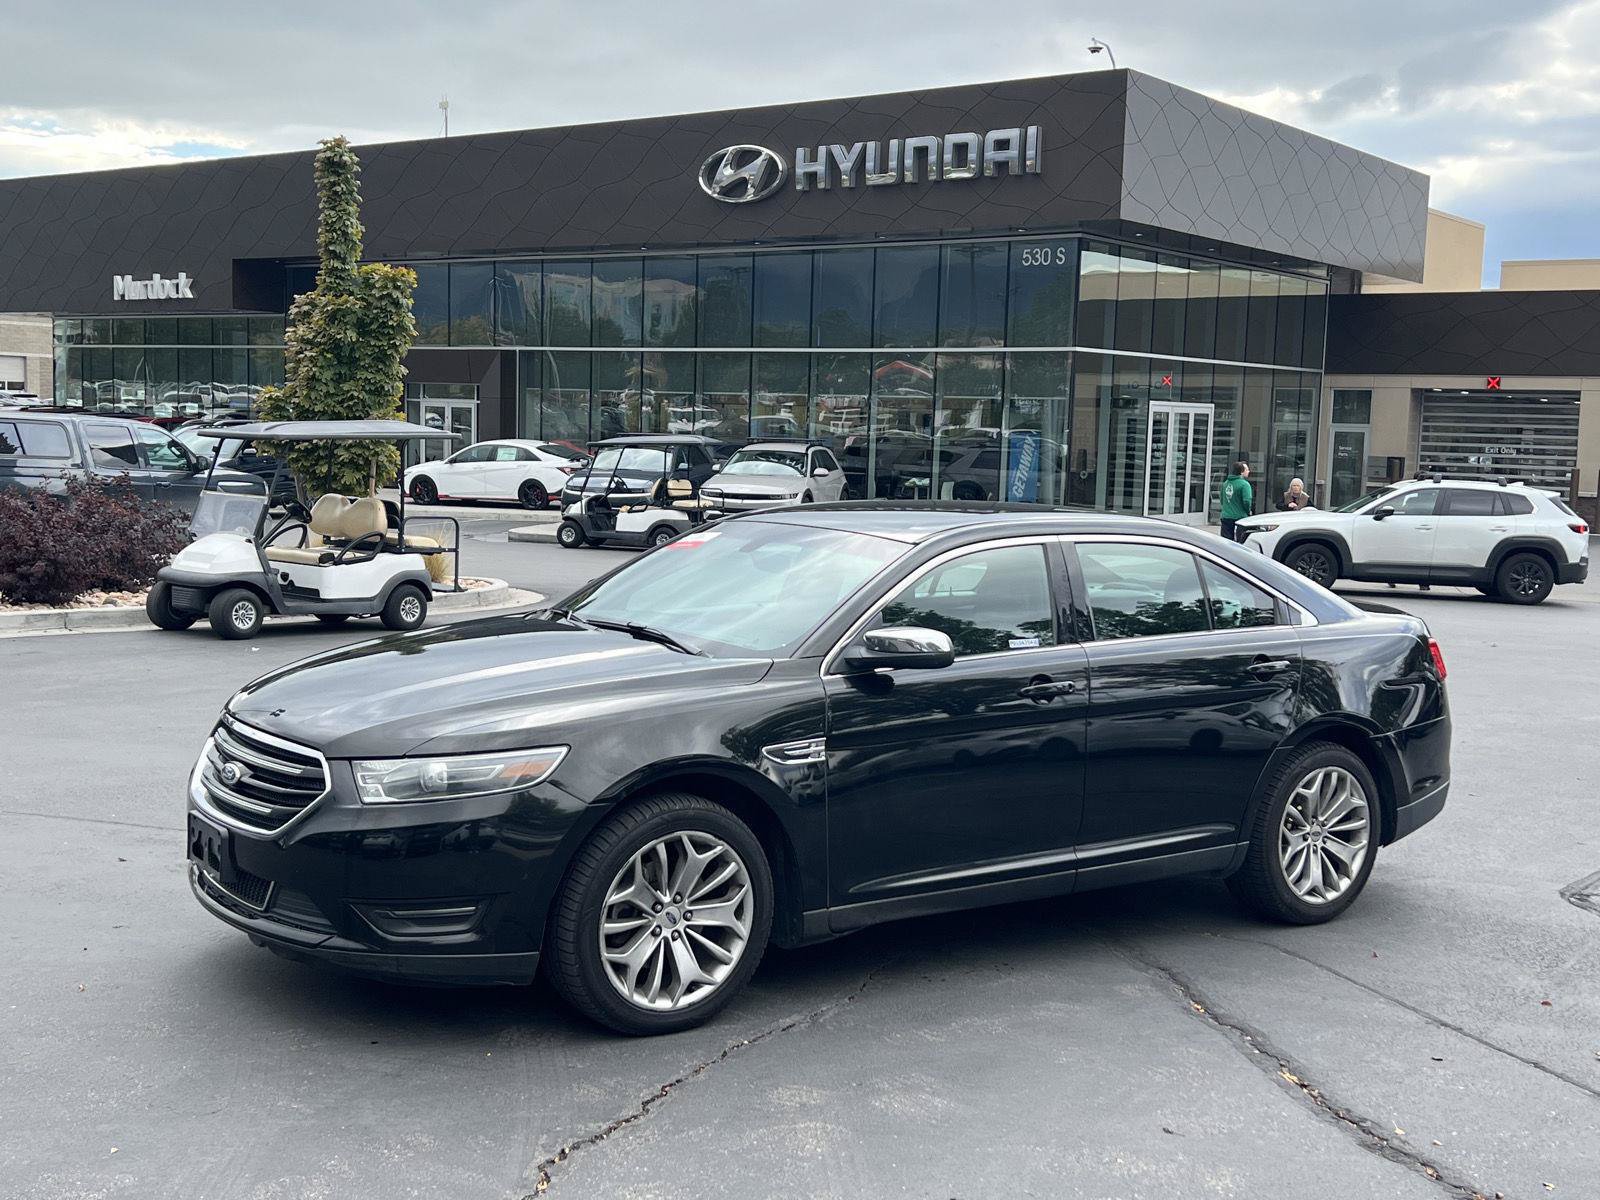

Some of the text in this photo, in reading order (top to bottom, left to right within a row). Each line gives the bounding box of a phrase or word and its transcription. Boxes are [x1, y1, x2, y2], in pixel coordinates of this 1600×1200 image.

[795, 125, 1043, 192] HYUNDAI
[1022, 247, 1066, 266] 530 S
[113, 272, 194, 301] Murdock
[1485, 446, 1517, 456] Exit Only
[1012, 436, 1036, 498] GETAWAY
